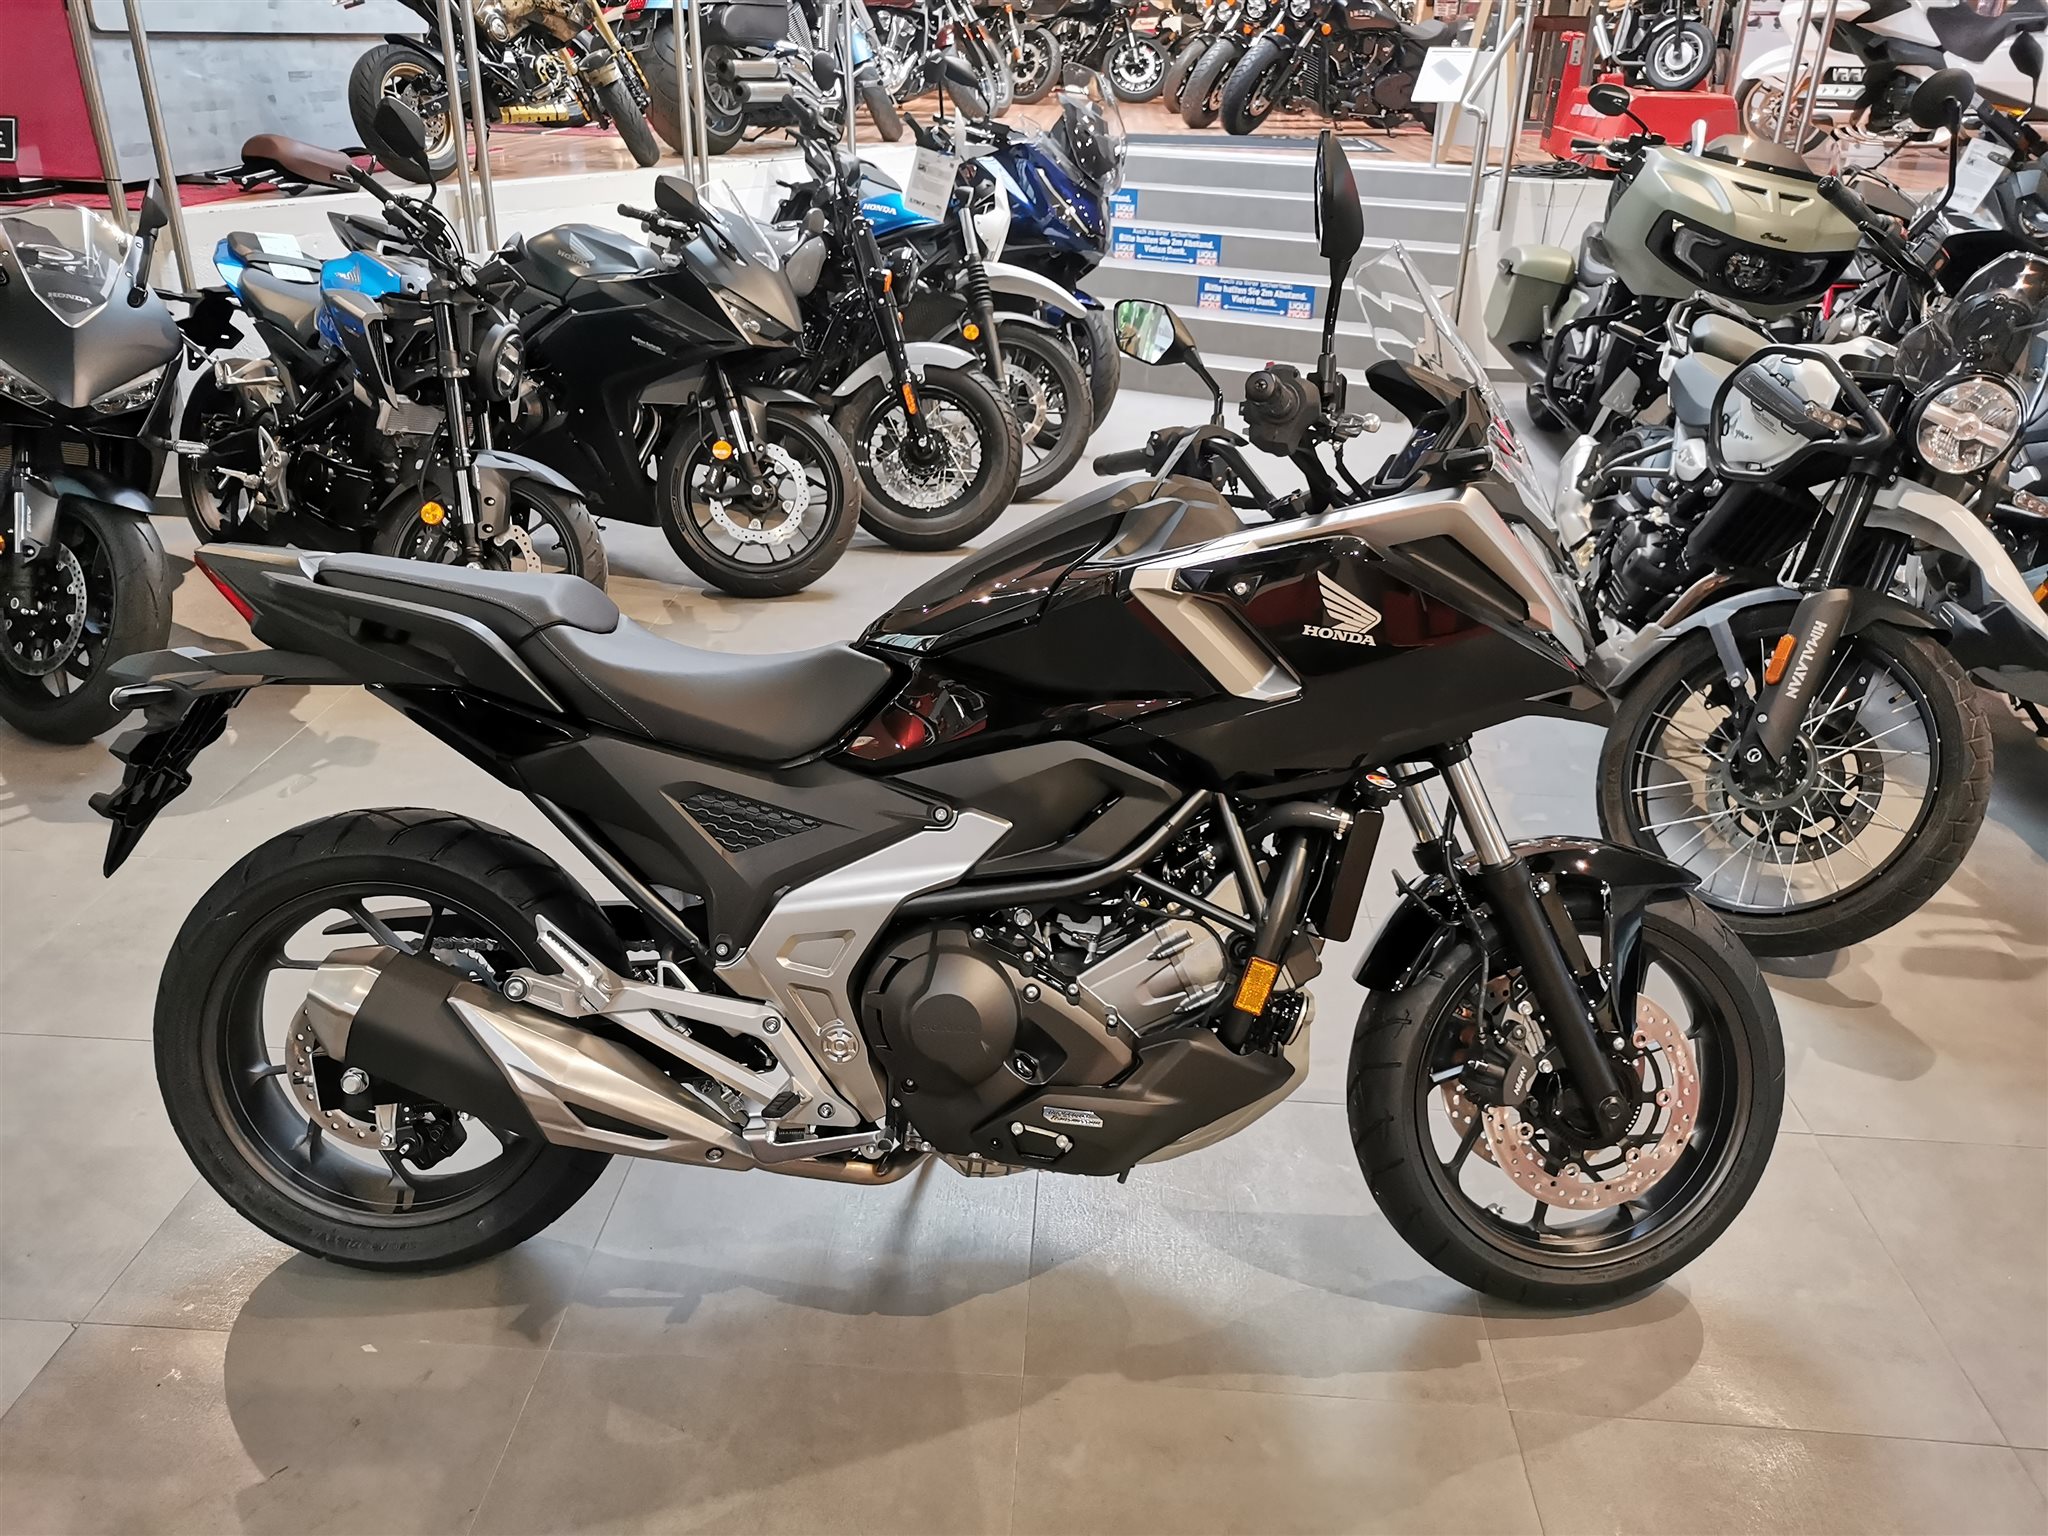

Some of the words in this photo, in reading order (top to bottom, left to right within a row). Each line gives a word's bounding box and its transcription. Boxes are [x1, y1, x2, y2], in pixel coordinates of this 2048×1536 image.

[862, 203, 897, 215] HONDA
[1223, 285, 1247, 294] halten
[1248, 287, 1260, 296] Sie
[48, 292, 92, 305] HONDA
[1302, 625, 1376, 646] HONDA
[1785, 620, 1828, 699] HIMALAYAN
